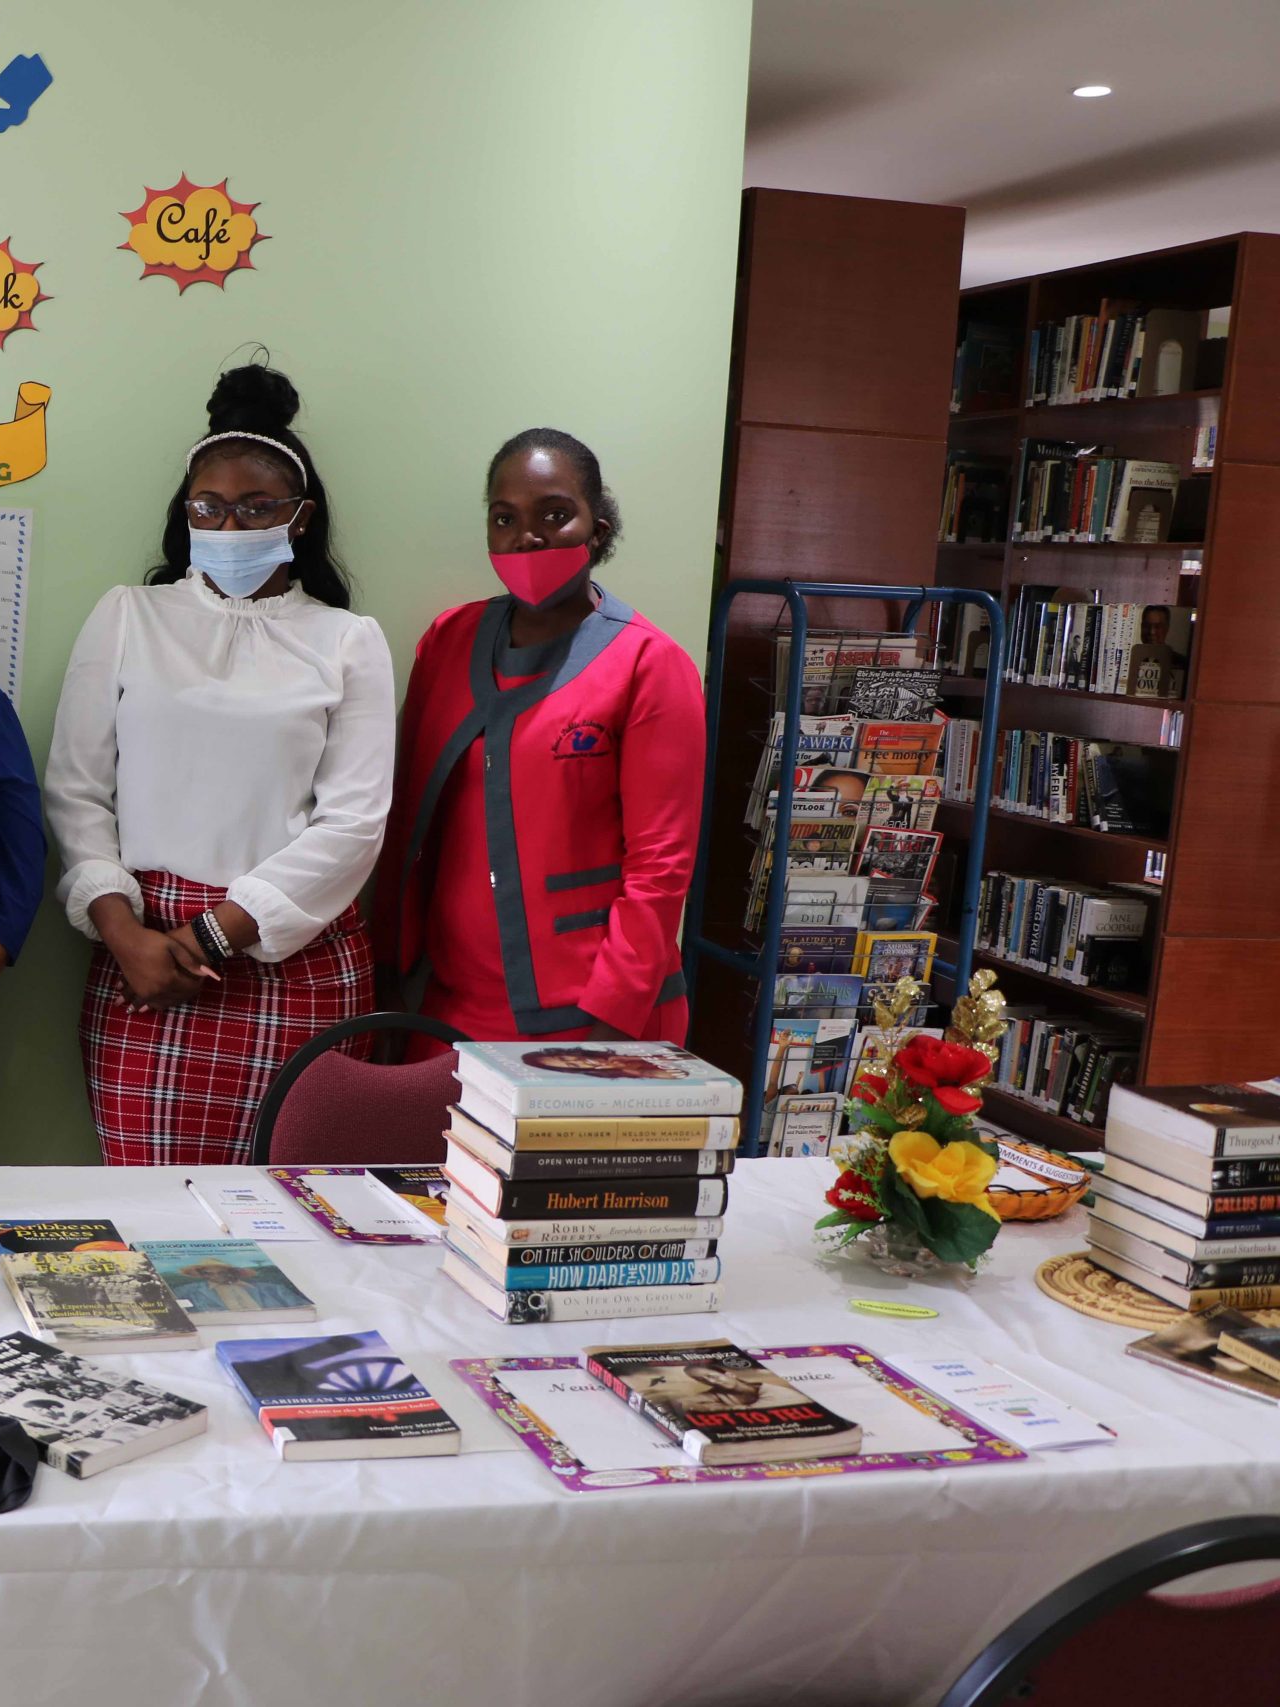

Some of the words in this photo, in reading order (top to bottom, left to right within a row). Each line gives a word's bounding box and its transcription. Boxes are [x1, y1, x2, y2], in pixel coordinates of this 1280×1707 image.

[156, 202, 231, 261] Café
[825, 651, 900, 667] OBSERVER
[912, 672, 942, 680] Magazine
[810, 737, 852, 749] WEEK
[864, 750, 890, 760] Free
[892, 751, 931, 763] money
[1051, 763, 1060, 777] MY
[1051, 778, 1060, 796] FBI
[821, 824, 855, 839] TREND
[1034, 887, 1045, 921] GREG
[800, 914, 825, 923] DID
[1109, 913, 1132, 923] JANE
[793, 936, 847, 947] LAUREATE
[1030, 922, 1041, 956] DYKE
[529, 1098, 595, 1109] BECOMING
[612, 1098, 671, 1108] MICHELLE
[529, 1131, 555, 1139] DARE
[557, 1131, 577, 1139] NOT
[578, 1131, 611, 1139] LINGER
[622, 1130, 658, 1138] NELSON
[1228, 1135, 1274, 1149] Thurgood
[538, 1157, 562, 1166] OPEN
[564, 1157, 589, 1166] WIDE
[591, 1156, 609, 1165] THE
[612, 1156, 652, 1165] FREEDOM
[655, 1155, 683, 1164] GATES
[1037, 1164, 1045, 1173] &
[547, 1192, 600, 1210] Hubert
[603, 1192, 669, 1209] Harrison
[1214, 1196, 1258, 1214] CALLUS
[1259, 1196, 1275, 1212] ON
[16, 1230, 94, 1238] Pirates
[551, 1223, 597, 1234] ROBIN
[1215, 1225, 1233, 1234] PETE
[1235, 1224, 1262, 1233] SOUZA
[540, 1233, 602, 1243] ROBERTS
[521, 1249, 543, 1265] ON
[544, 1247, 566, 1263] THE
[568, 1245, 636, 1263] SHOULDERS
[639, 1243, 657, 1260] OF
[1204, 1247, 1221, 1255] God
[1223, 1246, 1237, 1255] and
[1238, 1244, 1277, 1254] Starbucks
[548, 1267, 584, 1289] HOW
[588, 1264, 627, 1288] DARE
[638, 1262, 667, 1285] SUN
[1241, 1273, 1276, 1285] DAVID
[588, 1358, 603, 1378] LEFT
[602, 1368, 613, 1387] TO
[260, 1395, 334, 1406] CARIBBEAN
[335, 1395, 367, 1404] WARS
[373, 1391, 426, 1401] UNTOLD
[685, 1412, 736, 1428] LEFT
[735, 1411, 771, 1424] TO
[767, 1406, 824, 1421] TELL
